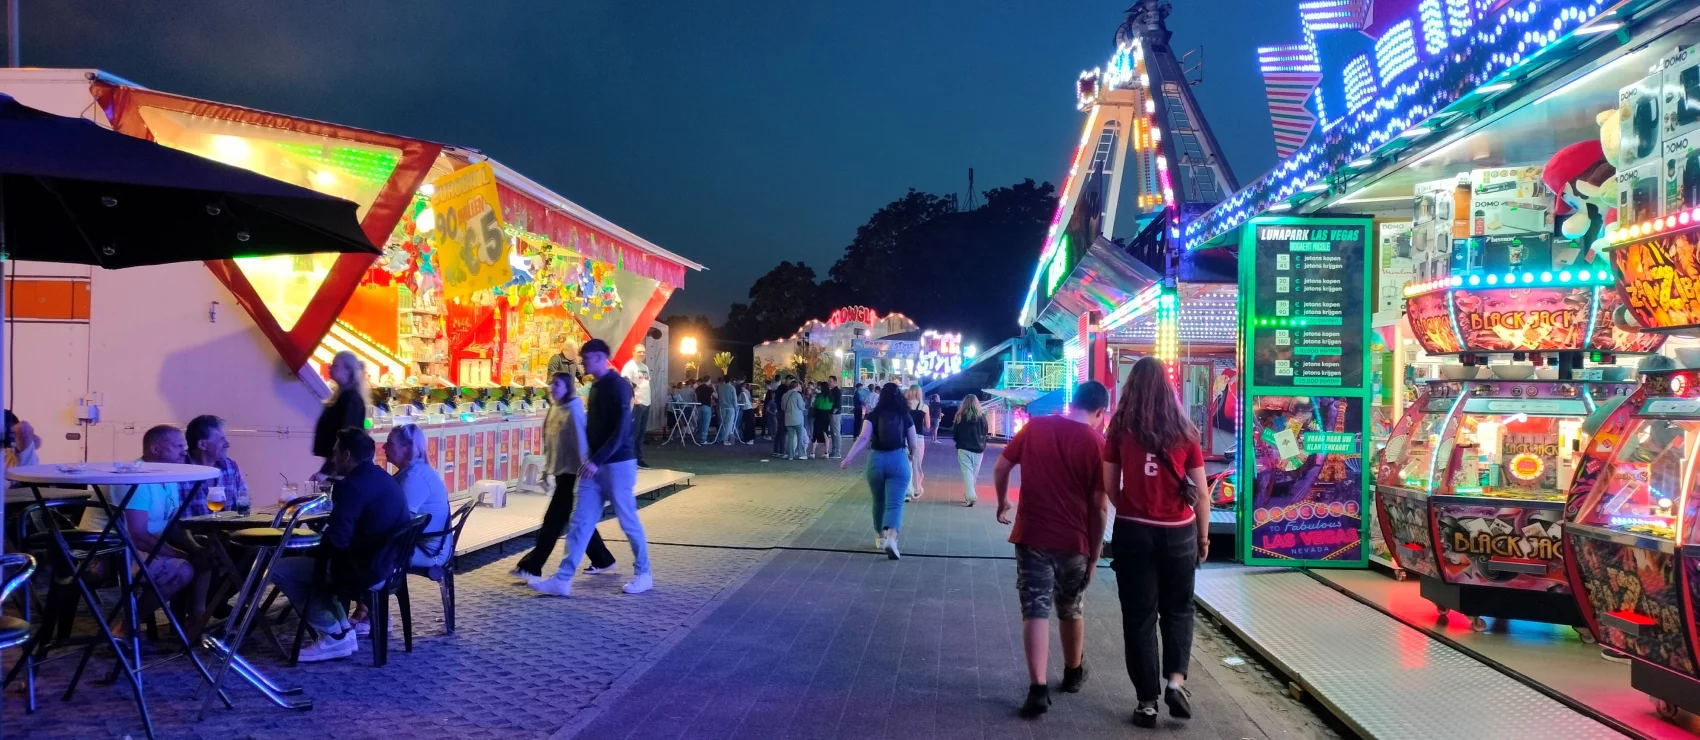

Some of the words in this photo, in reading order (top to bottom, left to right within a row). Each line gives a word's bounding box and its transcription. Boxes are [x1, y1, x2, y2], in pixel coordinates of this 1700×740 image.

[1664, 50, 1688, 69] DOMO
[1620, 87, 1638, 101] DOMO
[1620, 169, 1638, 184] DOMO
[1474, 200, 1500, 208] DOMO
[435, 206, 458, 245] 90
[1261, 229, 1310, 241] LUNAPARK
[1310, 229, 1330, 241] LAS
[1330, 229, 1360, 241] VEGAS
[830, 304, 877, 330] MOWGLI
[1470, 310, 1525, 330] BLACK
[1321, 338, 1342, 346] krijgen
[1321, 369, 1342, 377] krijgen
[1255, 501, 1359, 522] WELCOME
[1284, 519, 1342, 532] Fabulous
[1262, 532, 1296, 550] LAS
[1300, 528, 1359, 547] VEGAS
[1454, 532, 1523, 557] BLACK
[1527, 537, 1564, 559] JAC
[1291, 546, 1330, 555] NEVADA
